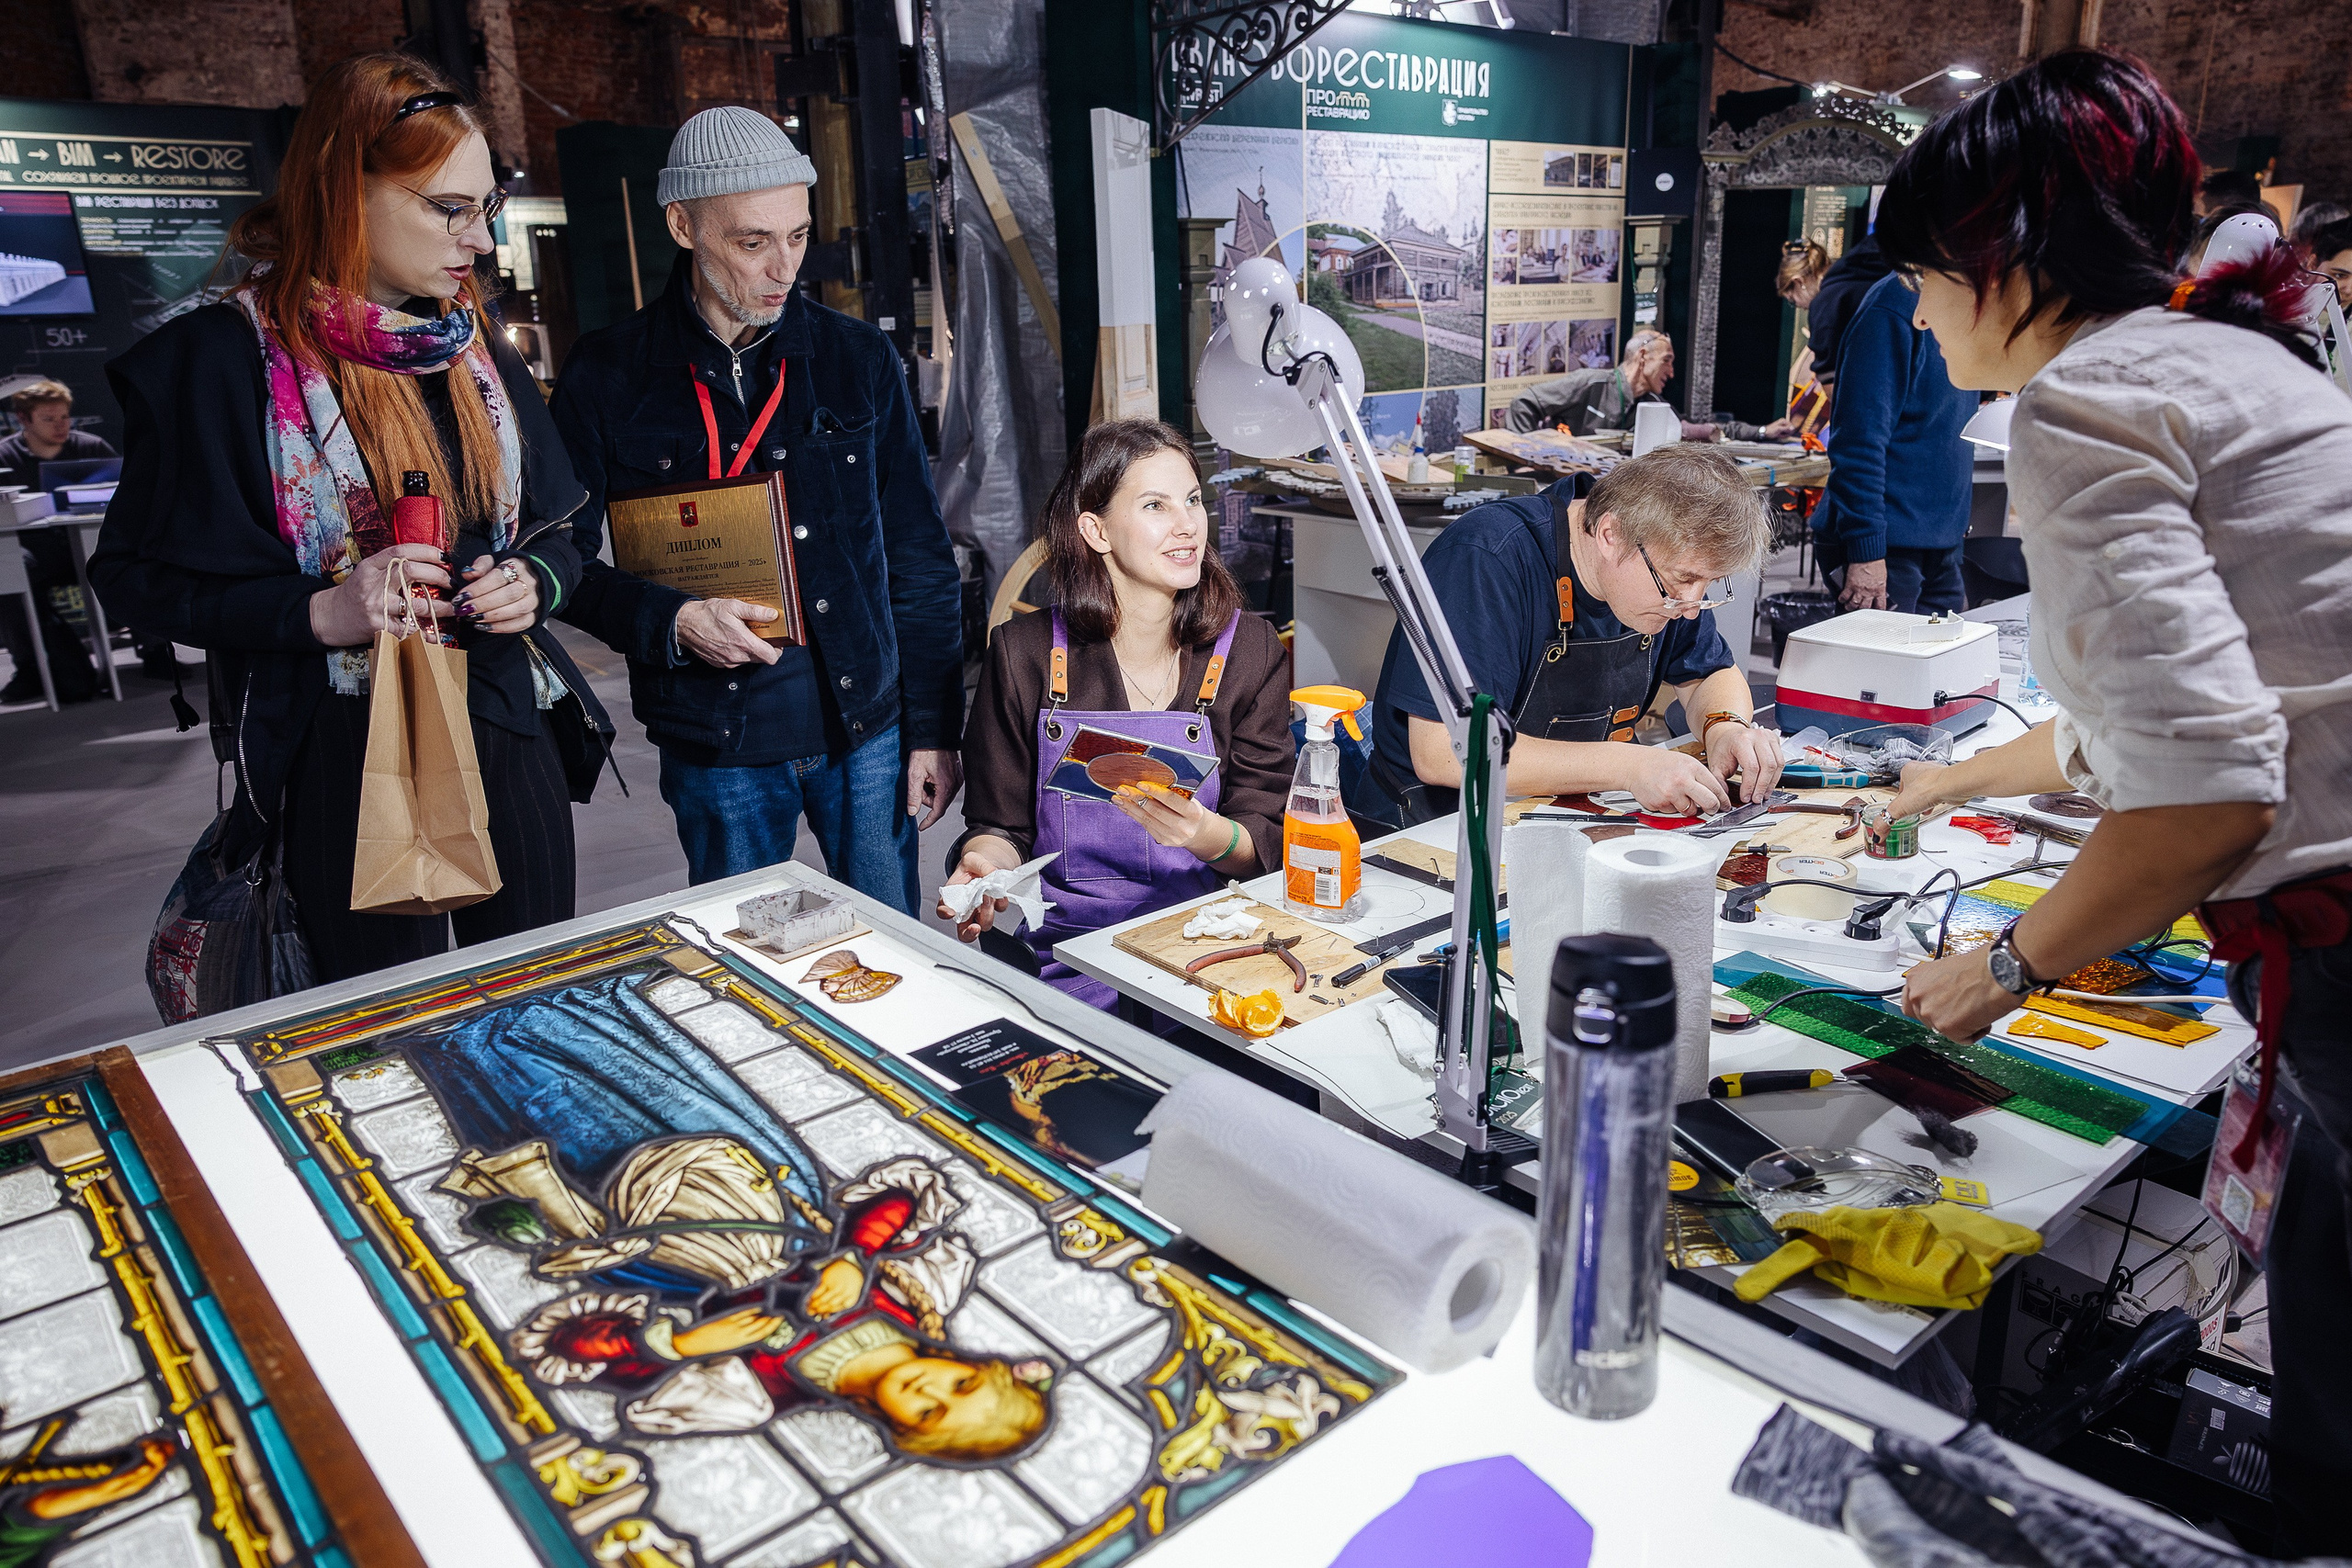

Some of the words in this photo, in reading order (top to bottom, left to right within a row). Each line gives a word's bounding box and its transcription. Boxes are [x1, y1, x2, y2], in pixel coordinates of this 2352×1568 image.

[1306, 106, 1371, 121] РЕСТАВРАЦИЮ
[56, 141, 96, 167] BIM
[46, 328, 88, 347] 50+
[666, 537, 722, 556] ДИПЛОМ
[685, 560, 740, 572] РЕСТАВРАЦИЯ
[677, 573, 719, 582] НАГРАЖДАЕТСЯ
[1495, 1110, 1518, 1124] 2025
